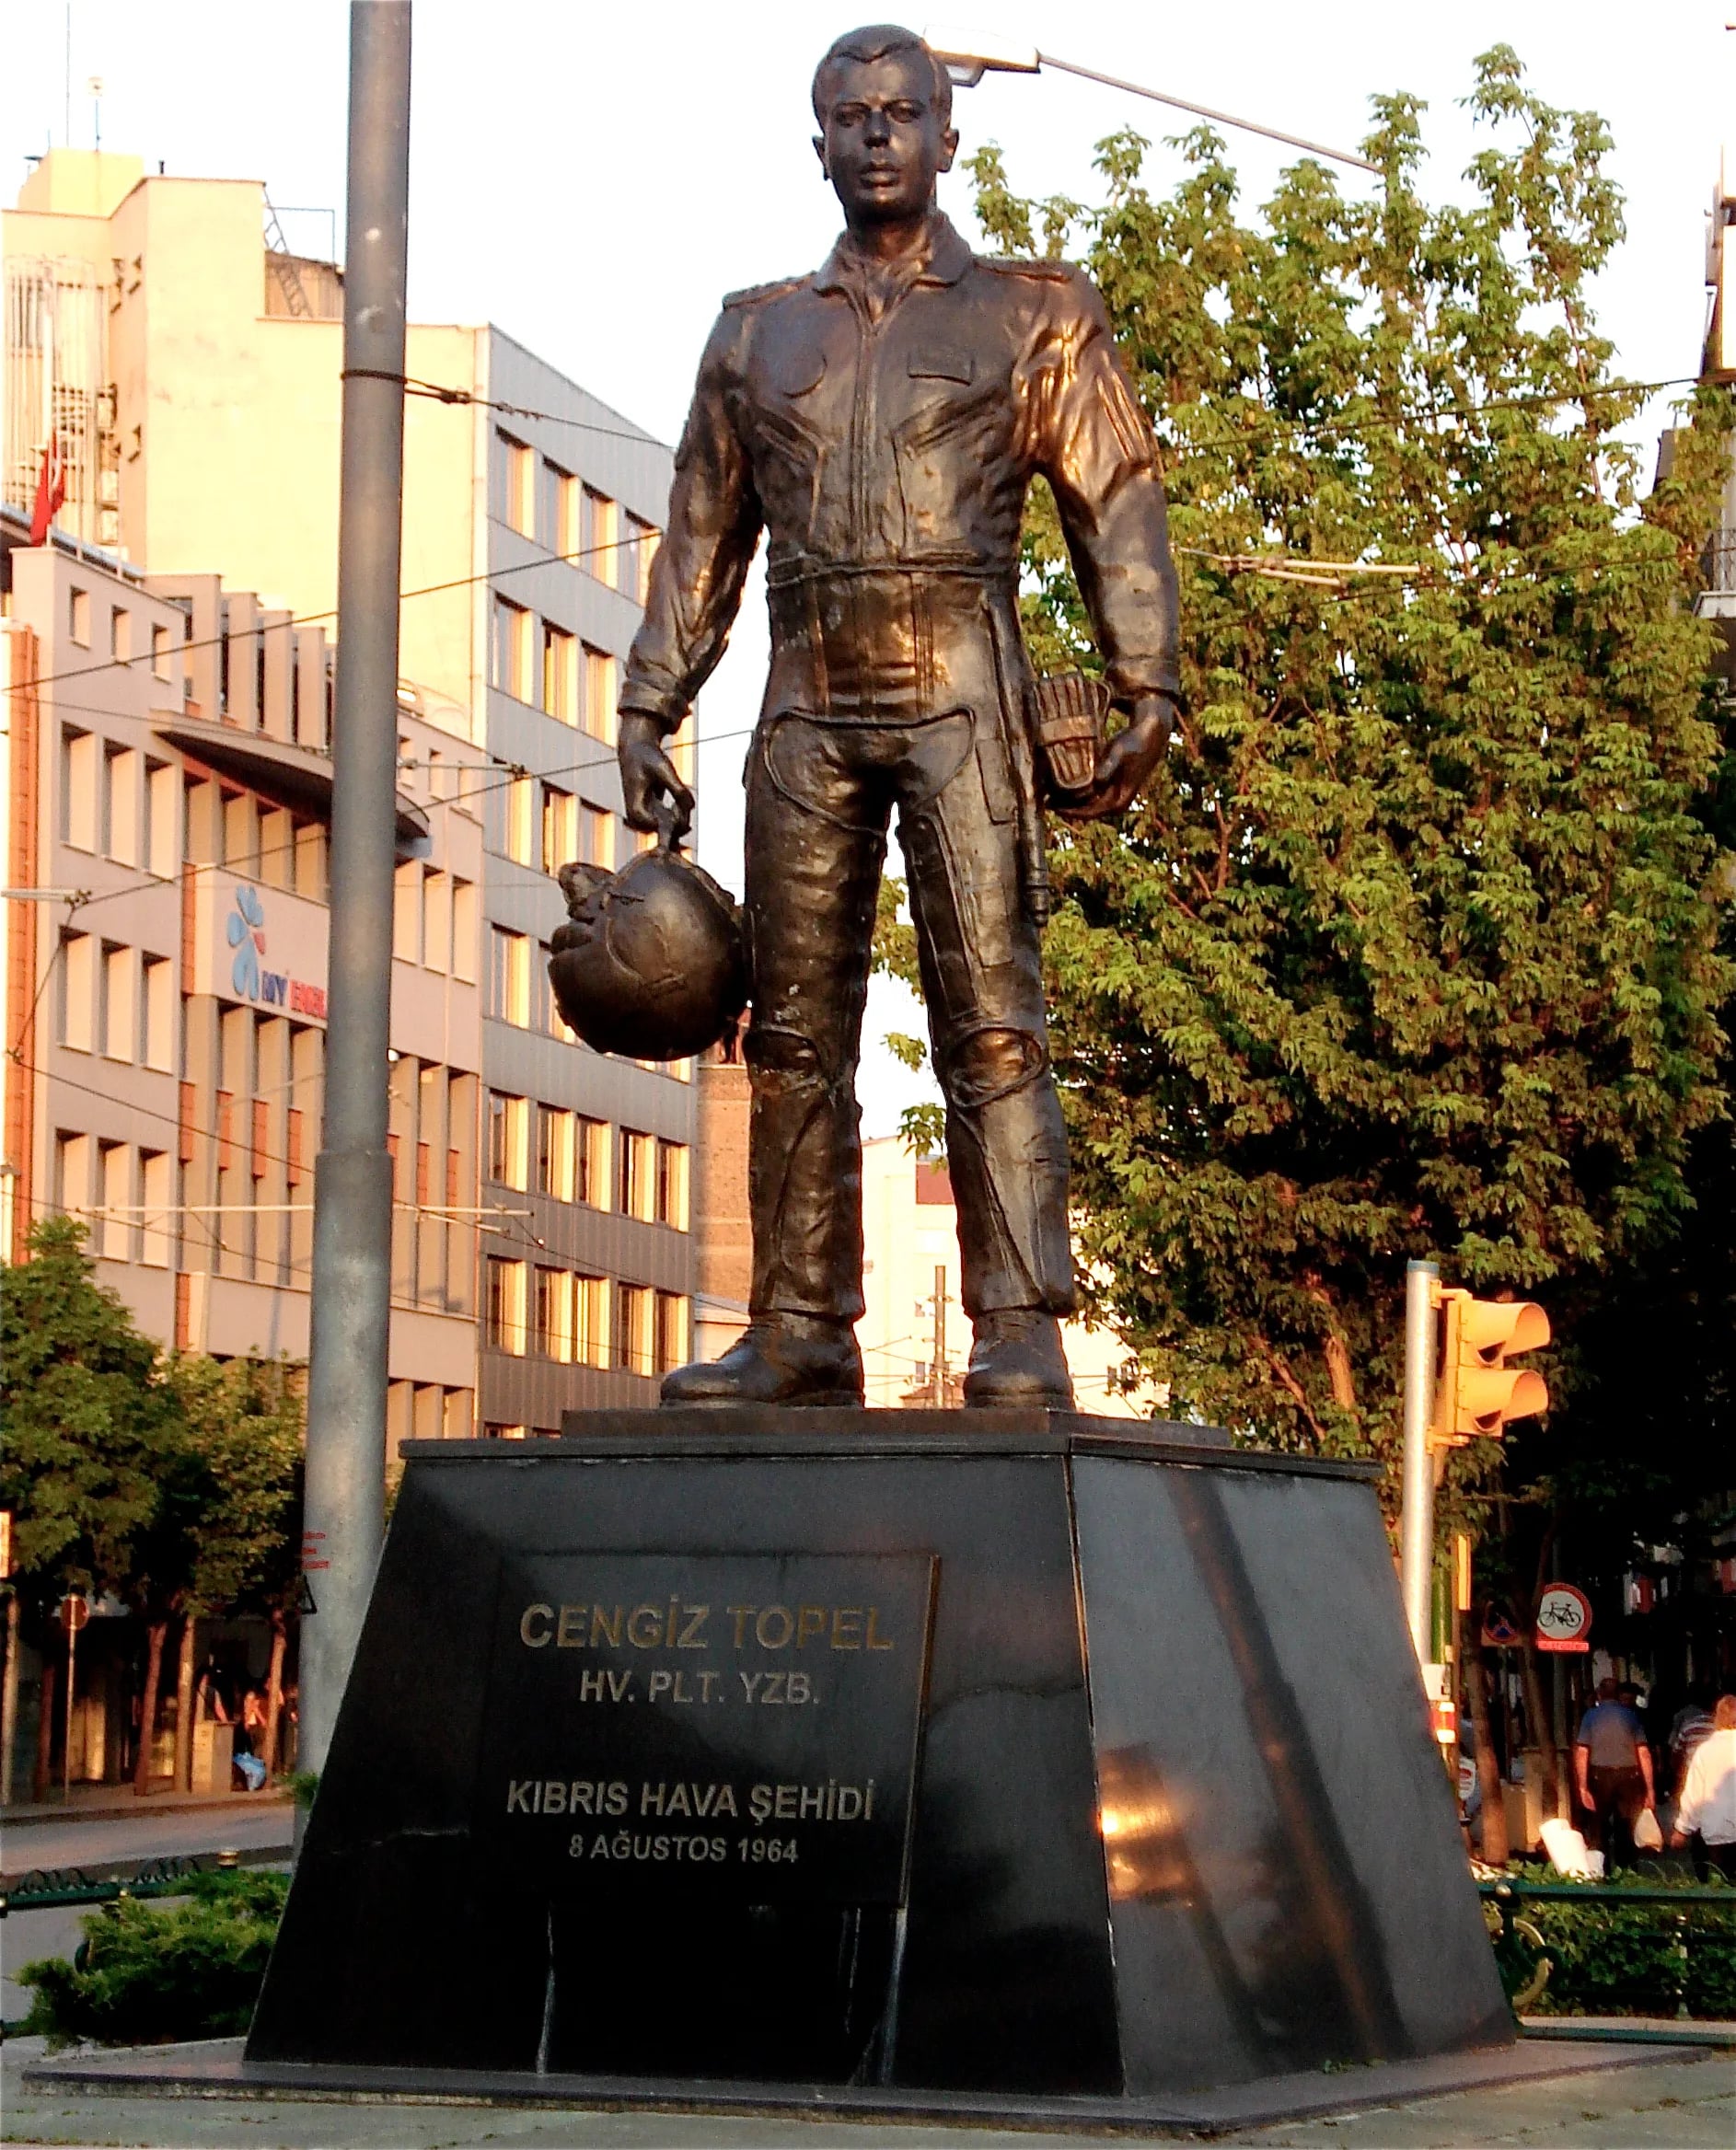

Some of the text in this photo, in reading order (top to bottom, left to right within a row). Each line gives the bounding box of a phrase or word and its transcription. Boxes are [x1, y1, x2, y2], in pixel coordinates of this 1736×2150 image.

[520, 1594, 895, 1651] CENGİZ TOPEL
[580, 1670, 820, 1705] HV. PLT. YZB.
[506, 1778, 875, 1826] KIBRIS HAVA ŞEHİDİ
[569, 1829, 799, 1864] 8 AĞUSTOS 1964
